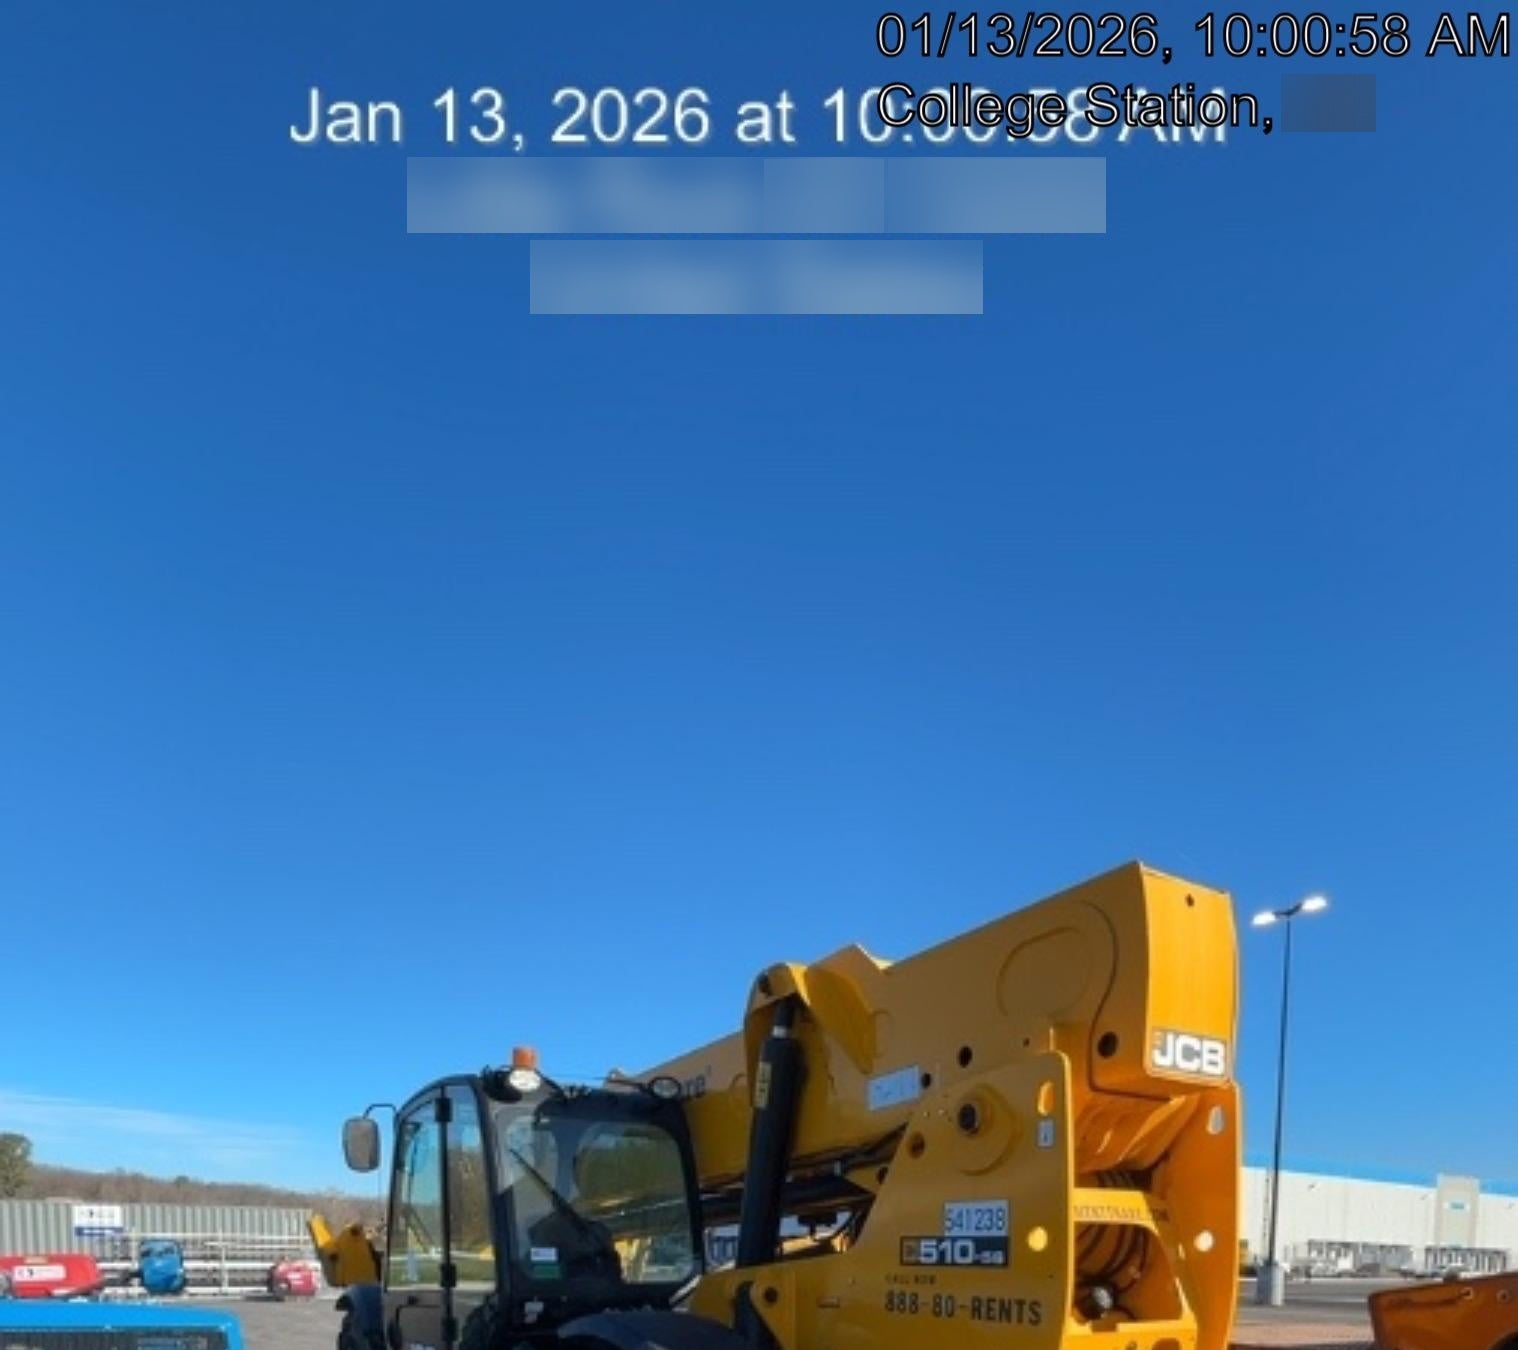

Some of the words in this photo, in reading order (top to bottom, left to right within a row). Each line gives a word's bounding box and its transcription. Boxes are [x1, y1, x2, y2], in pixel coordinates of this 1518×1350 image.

[1152, 1031, 1225, 1076] JCB
[944, 1206, 1006, 1232] 541238
[885, 1290, 1042, 1326] 888-80-RENTS
